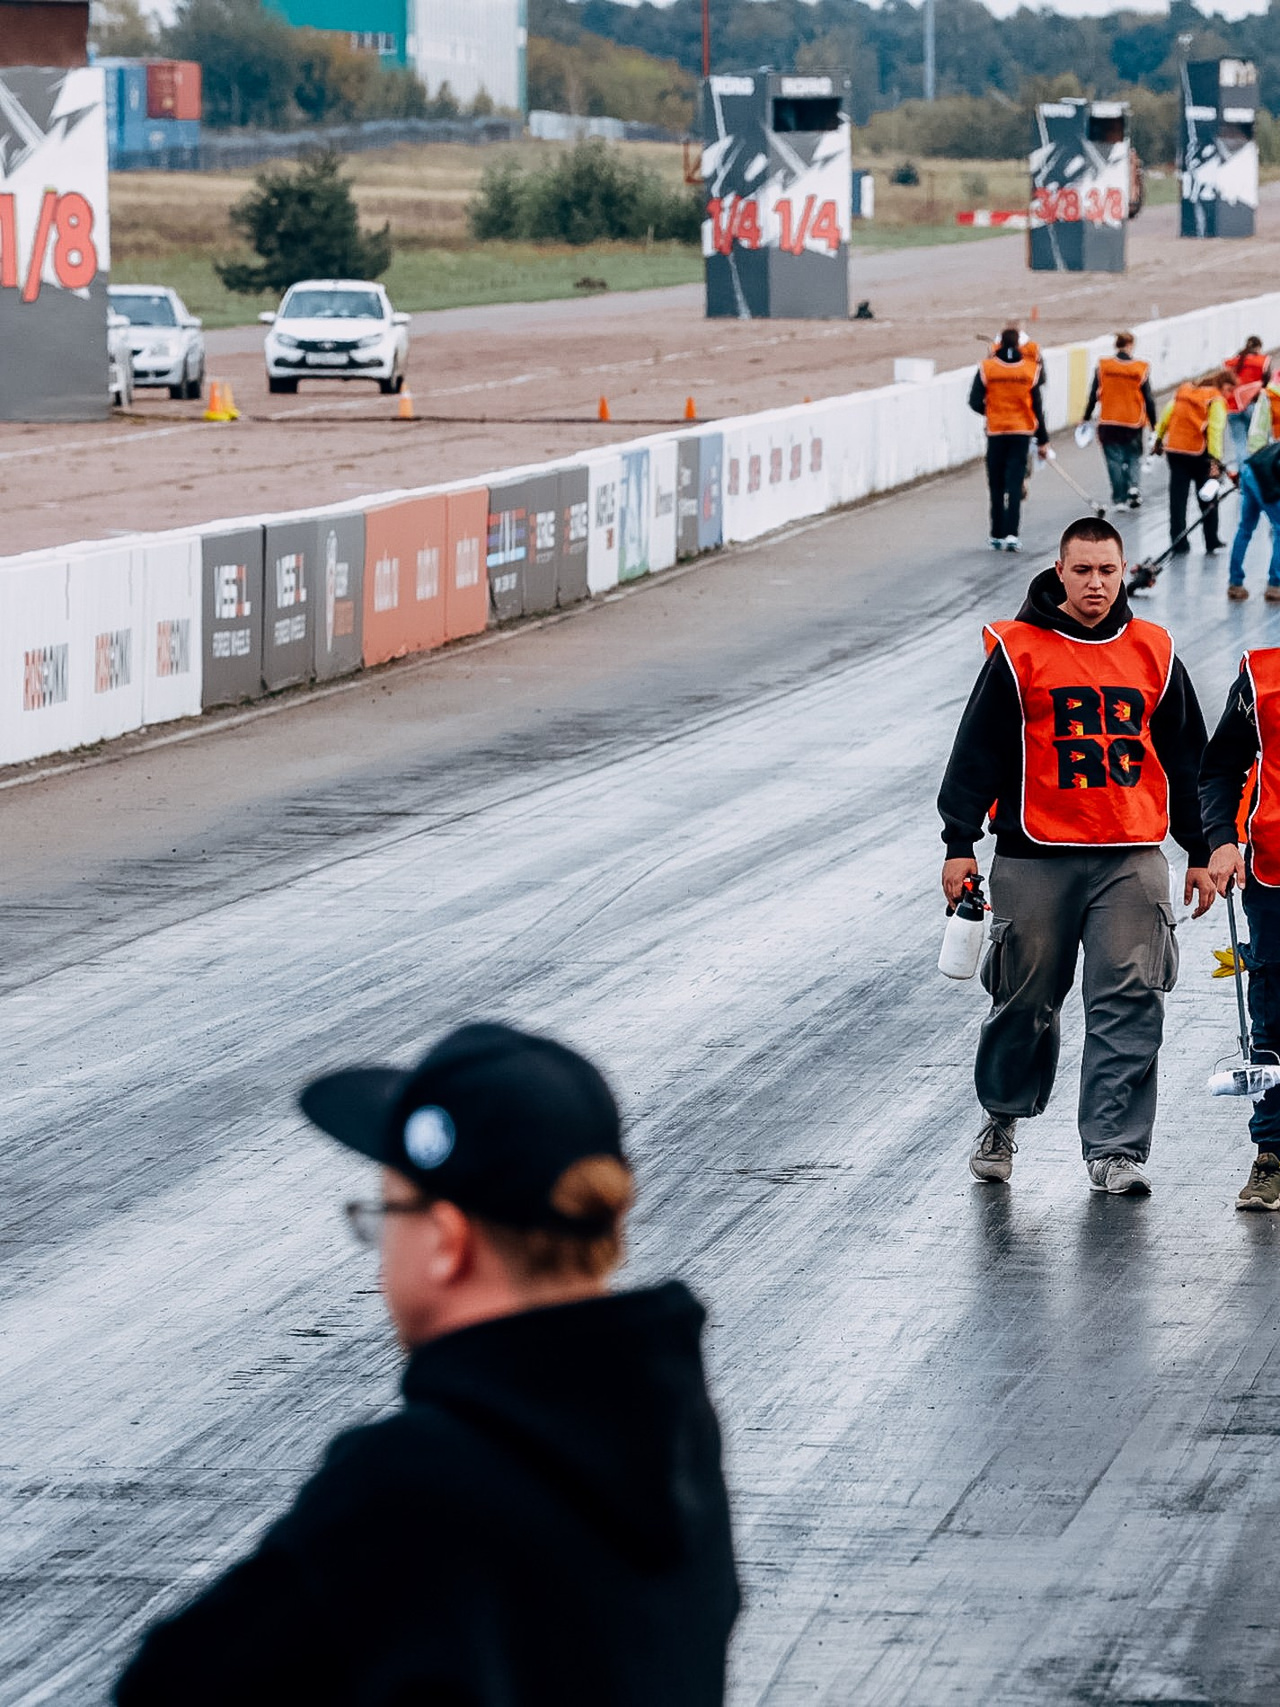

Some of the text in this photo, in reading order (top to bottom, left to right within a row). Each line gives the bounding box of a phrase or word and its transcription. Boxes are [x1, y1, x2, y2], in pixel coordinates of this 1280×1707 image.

[706, 194, 762, 256] 1/4
[772, 193, 842, 256] 1/4
[1049, 686, 1146, 737] RD
[1052, 738, 1146, 790] RC
